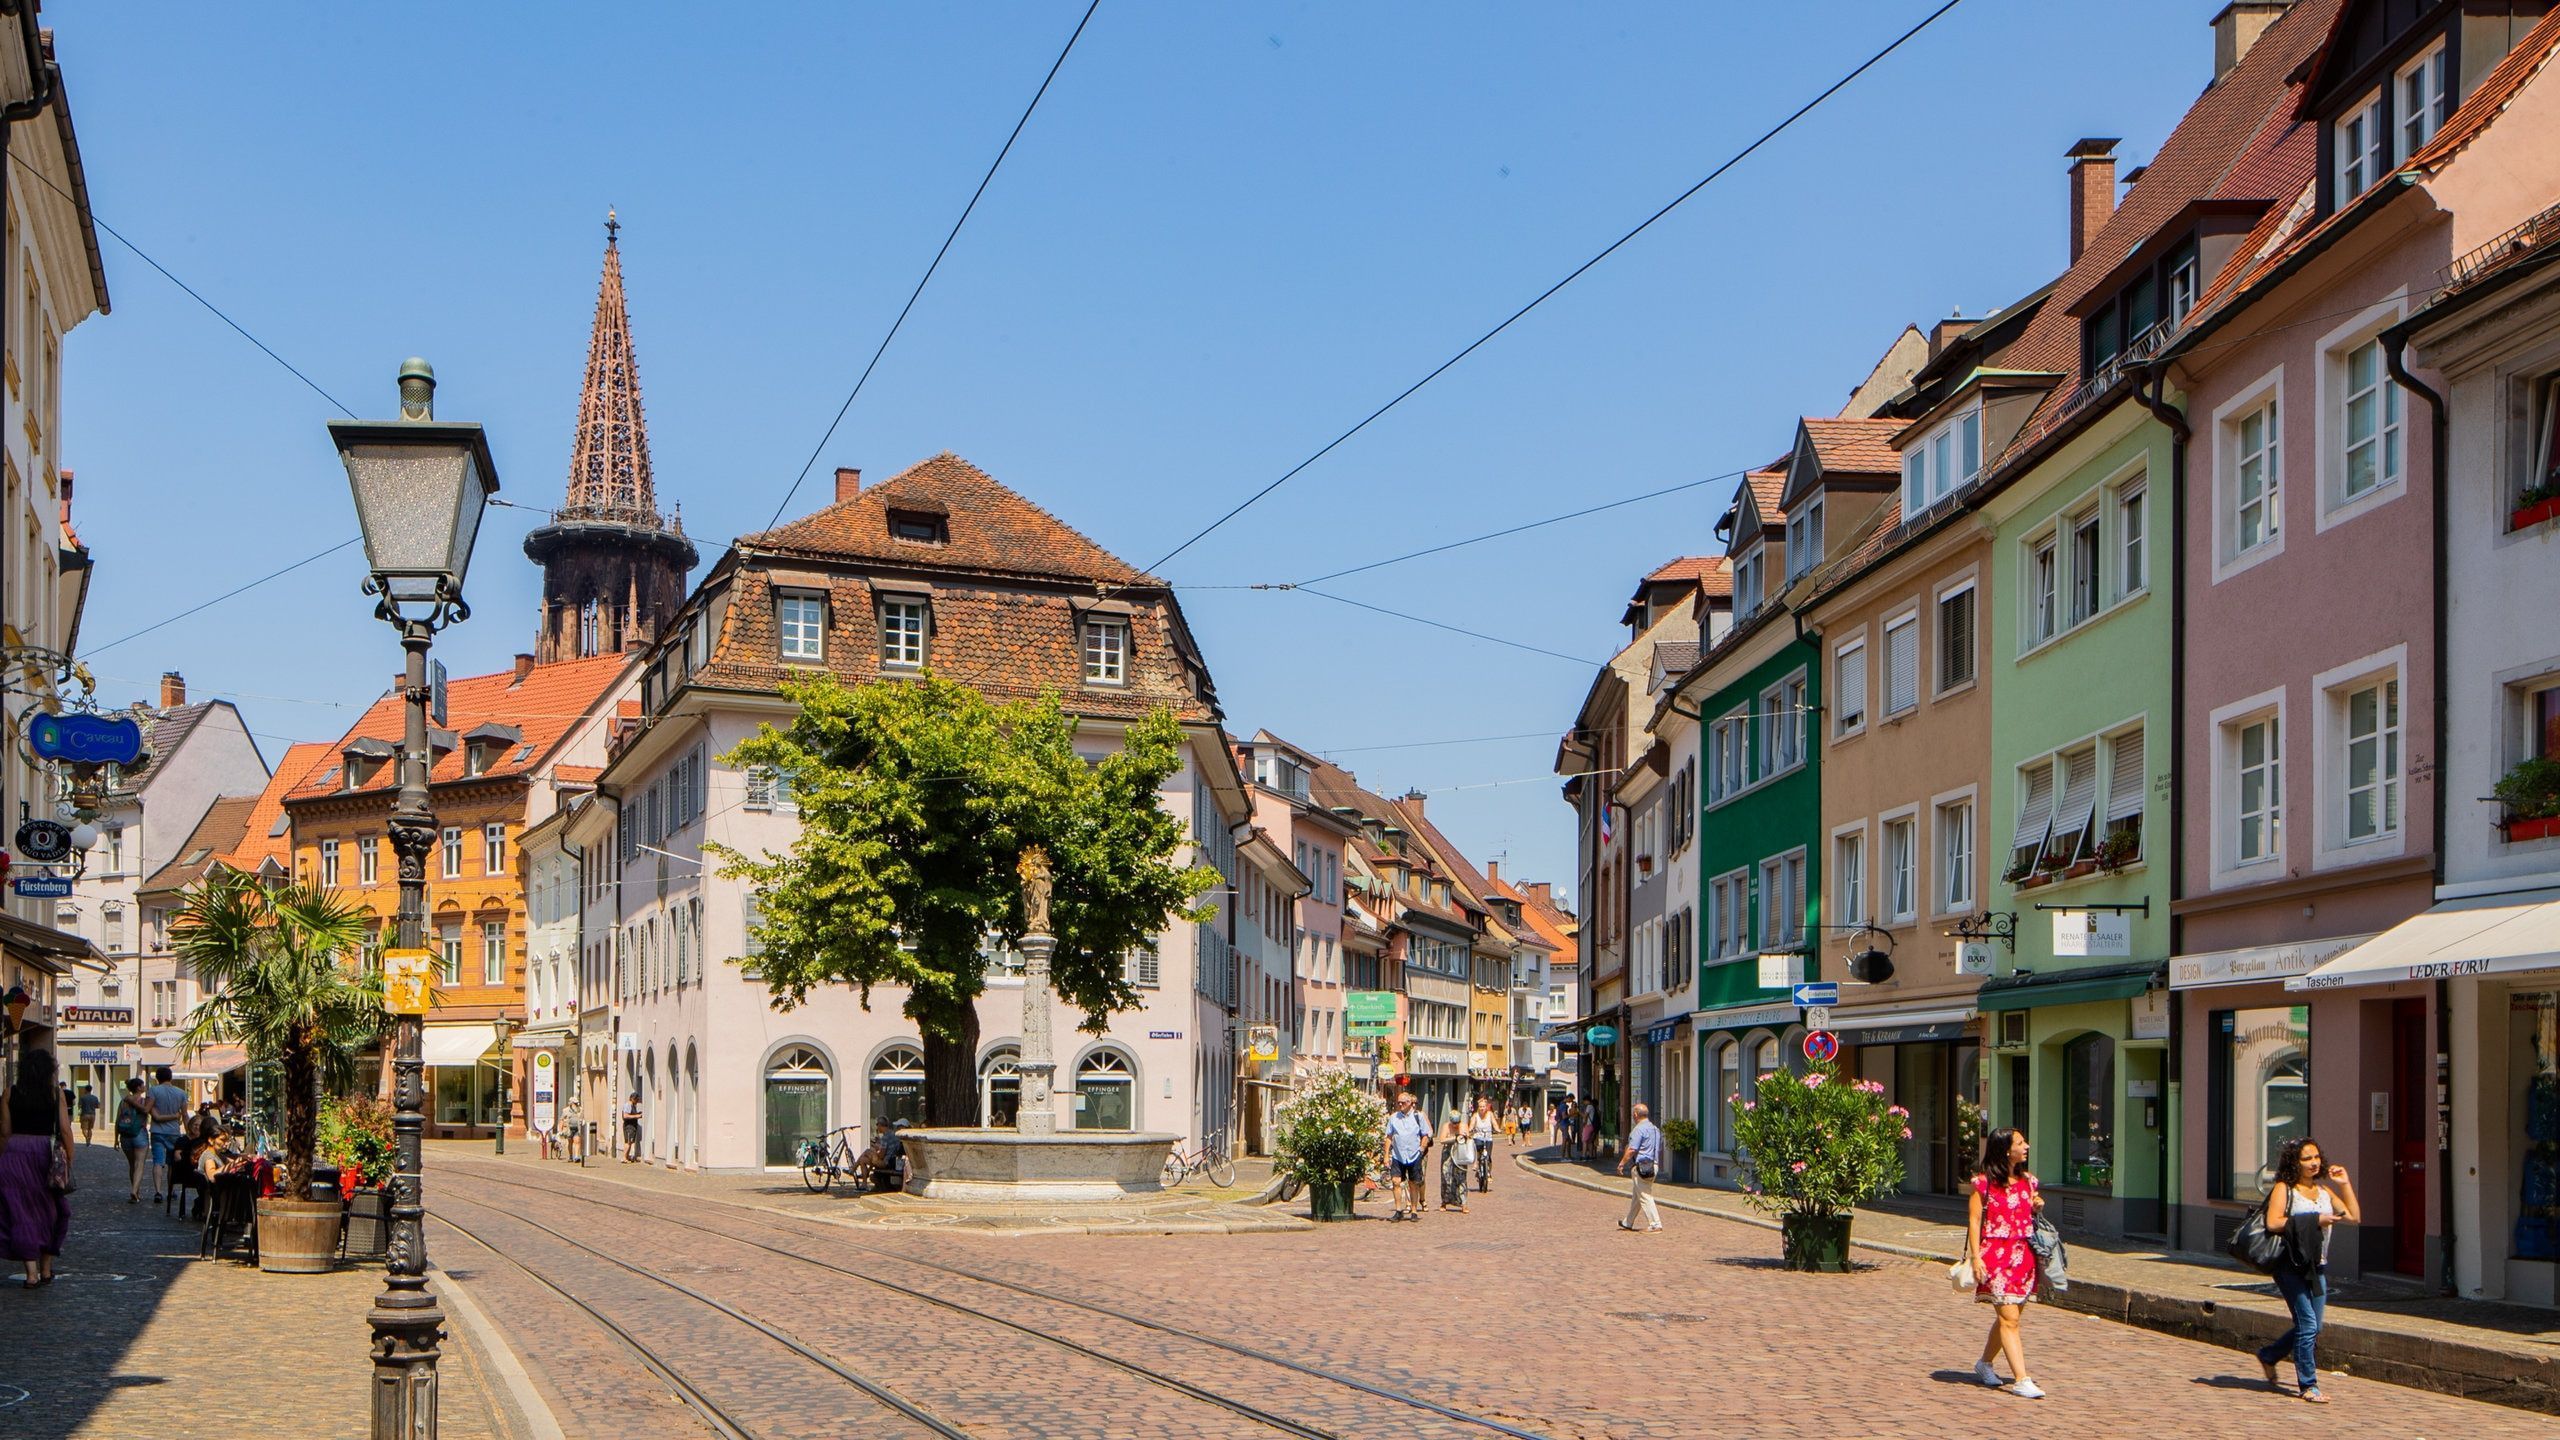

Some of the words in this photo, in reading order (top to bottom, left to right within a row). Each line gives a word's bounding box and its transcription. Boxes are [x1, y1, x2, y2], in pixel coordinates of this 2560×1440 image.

[71, 730, 124, 748] Caveau
[20, 880, 68, 895] Fürstenberg
[2274, 948, 2306, 971] Antik
[2179, 963, 2202, 981] DESIGN
[2306, 975, 2344, 988] Taschen
[68, 1010, 129, 1022] VITALIA
